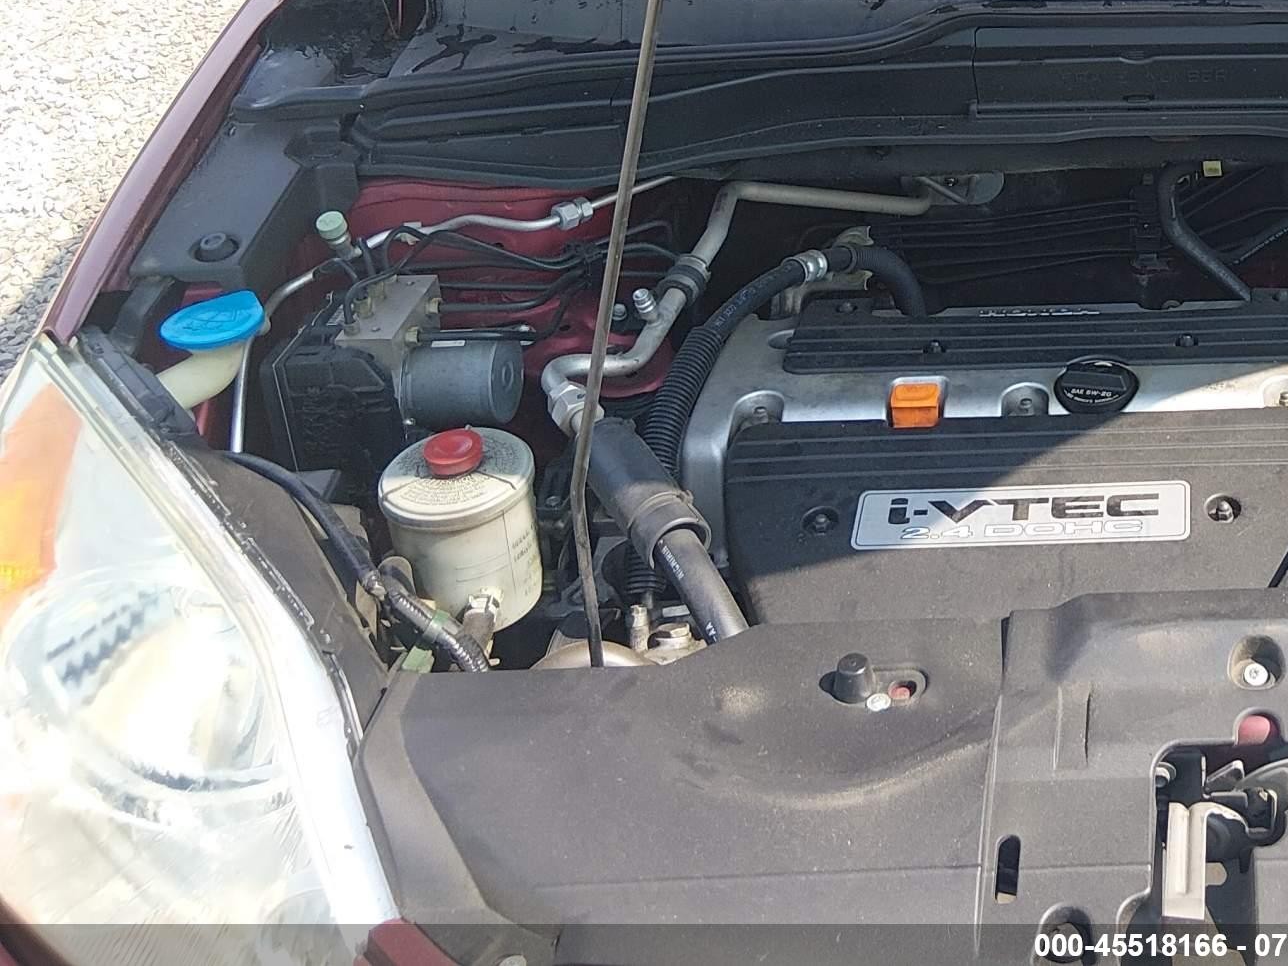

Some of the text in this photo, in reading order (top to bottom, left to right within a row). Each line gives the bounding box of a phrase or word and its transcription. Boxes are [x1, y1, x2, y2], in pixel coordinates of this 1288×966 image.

[888, 493, 1159, 524] i-VTEC
[901, 520, 1143, 539] 2.4 DOHC
